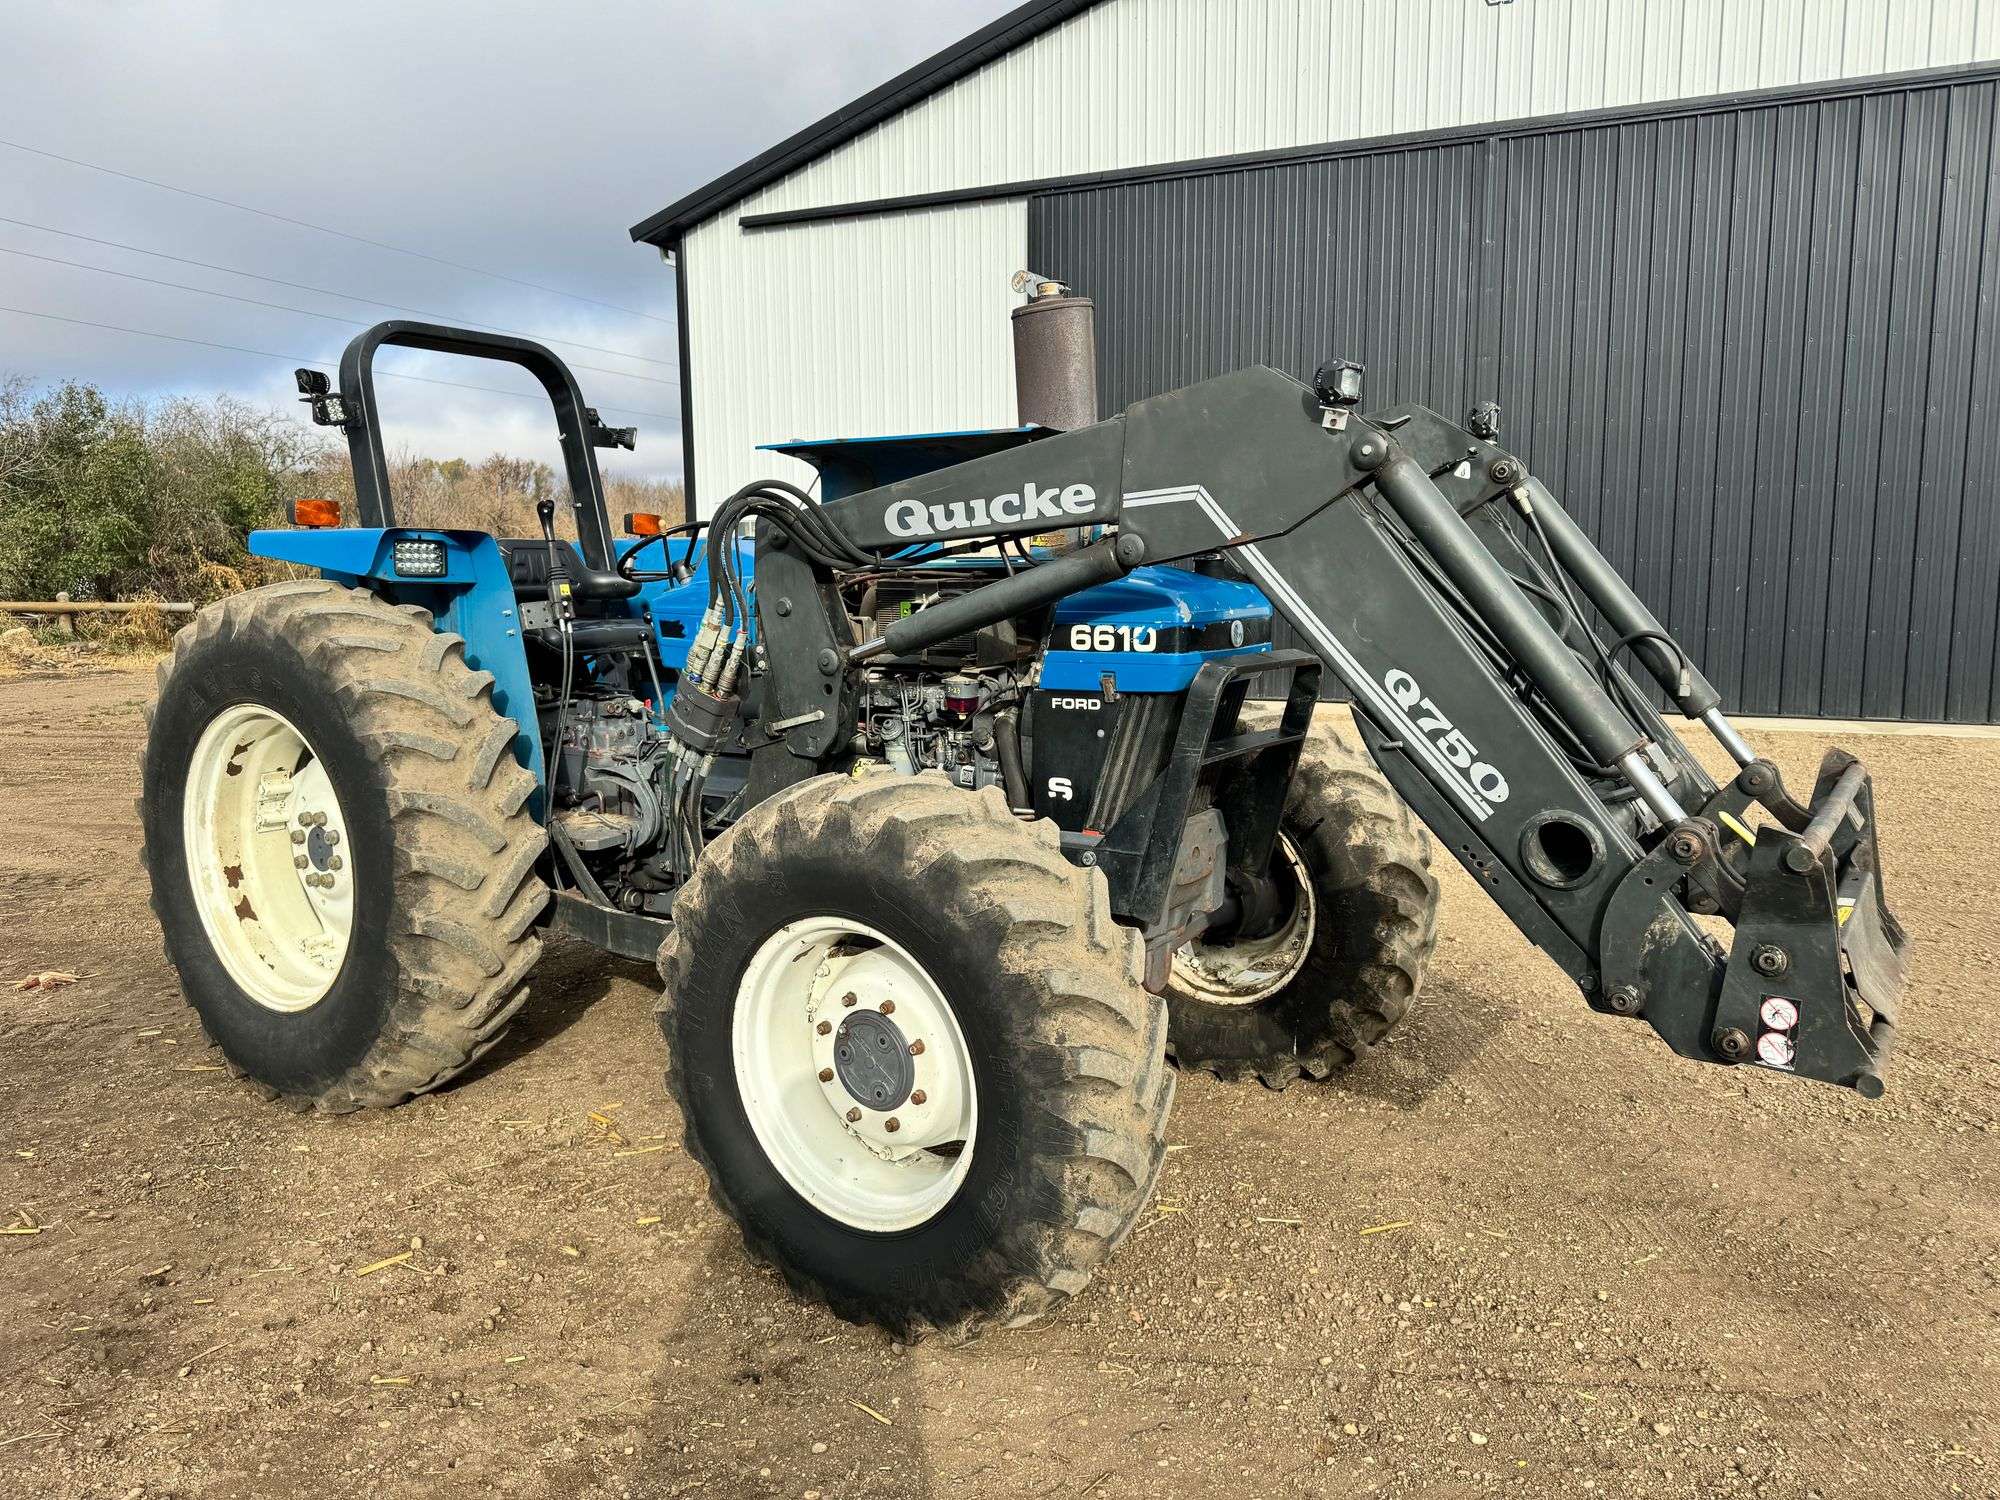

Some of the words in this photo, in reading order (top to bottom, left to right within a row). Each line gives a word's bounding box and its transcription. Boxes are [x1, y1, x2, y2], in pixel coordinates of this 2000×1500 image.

[884, 482, 1096, 537] Quicke
[1070, 624, 1157, 652] 6610
[1051, 698, 1101, 711] FORD
[1384, 668, 1510, 803] Q750
[1047, 776, 1073, 801] S
